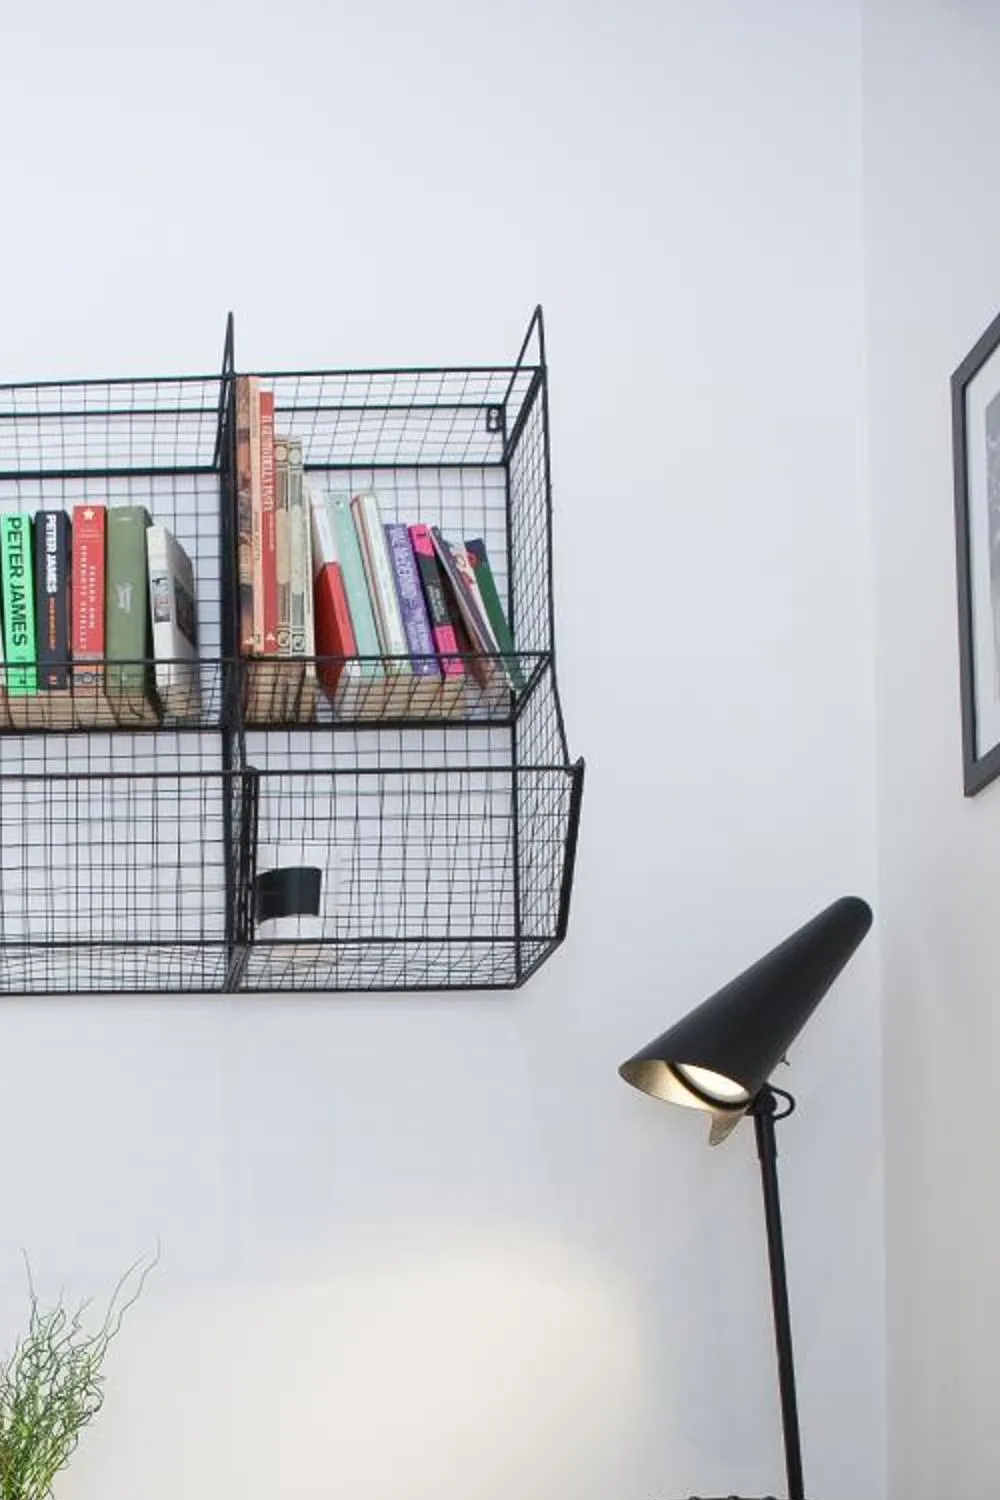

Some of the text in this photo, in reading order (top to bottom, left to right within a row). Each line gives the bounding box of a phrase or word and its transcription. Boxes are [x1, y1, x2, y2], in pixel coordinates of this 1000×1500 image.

[45, 513, 57, 552] PETER
[7, 517, 28, 647] PETER JAMES
[46, 553, 57, 593] JAMES
